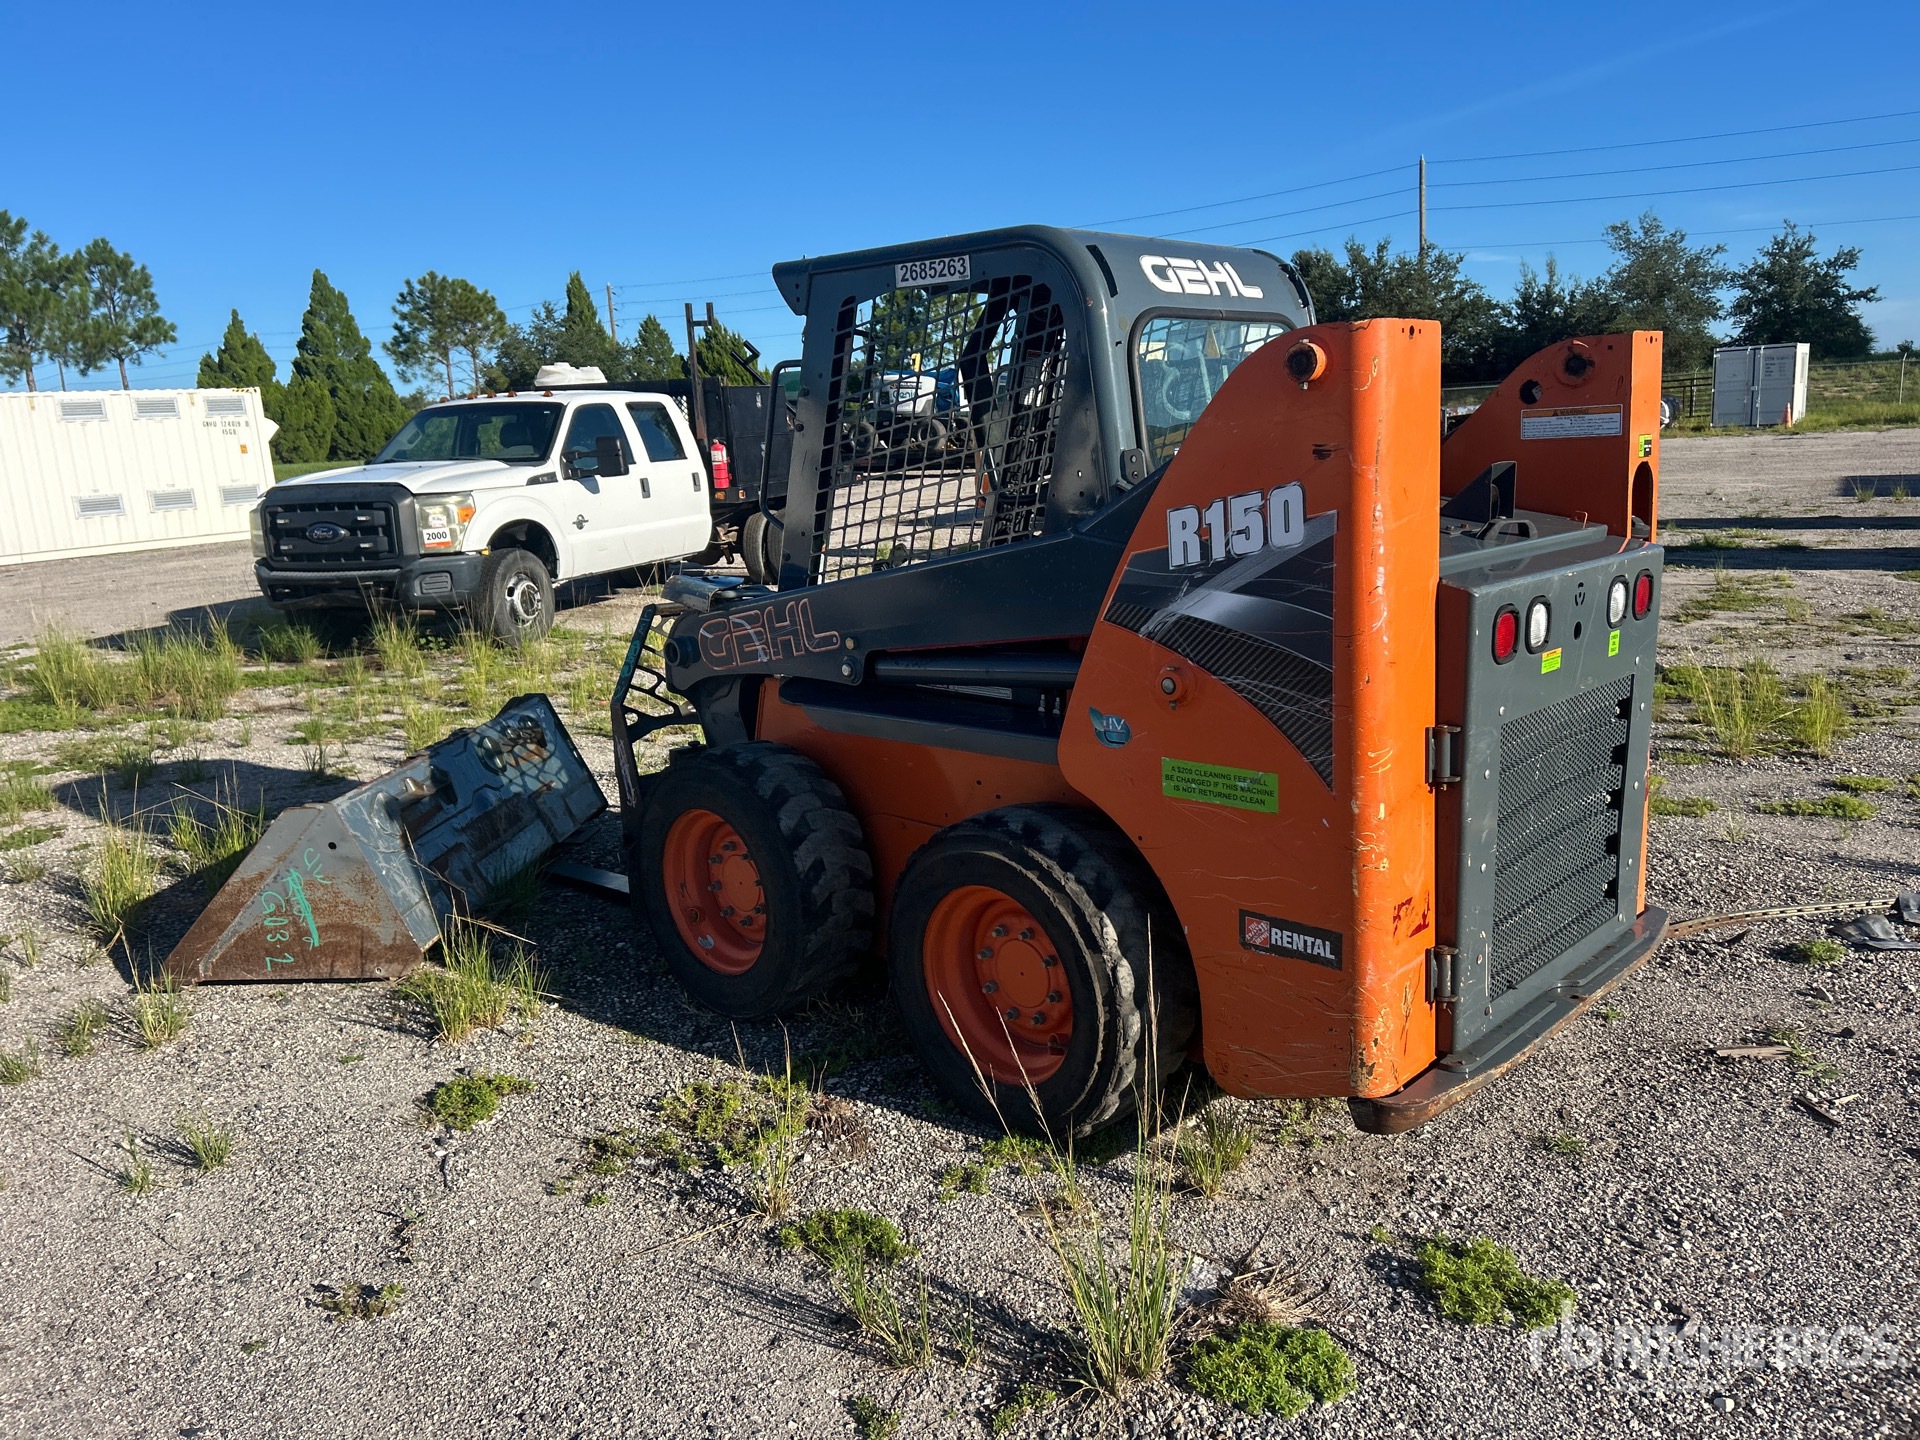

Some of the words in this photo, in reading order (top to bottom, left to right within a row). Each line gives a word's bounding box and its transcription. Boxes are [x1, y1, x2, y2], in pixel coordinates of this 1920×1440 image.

[900, 257, 968, 282] 2685263
[1139, 254, 1264, 299] GEHL
[312, 527, 334, 539] Ford
[425, 531, 448, 541] 2000
[1166, 481, 1307, 570] R150
[699, 598, 842, 670] GEHL
[1165, 774, 1175, 782] BE
[1176, 776, 1212, 788] CHARGED
[1221, 782, 1239, 792] THIS
[1240, 785, 1276, 798] MACHINE
[1177, 767, 1193, 775] $200
[1194, 769, 1232, 781] CLEANING
[1173, 784, 1181, 792] IS
[1181, 786, 1197, 794] NOT
[1198, 789, 1239, 801] RETURNED
[1239, 795, 1267, 806] CLEAN
[1270, 927, 1336, 960] RENTAL
